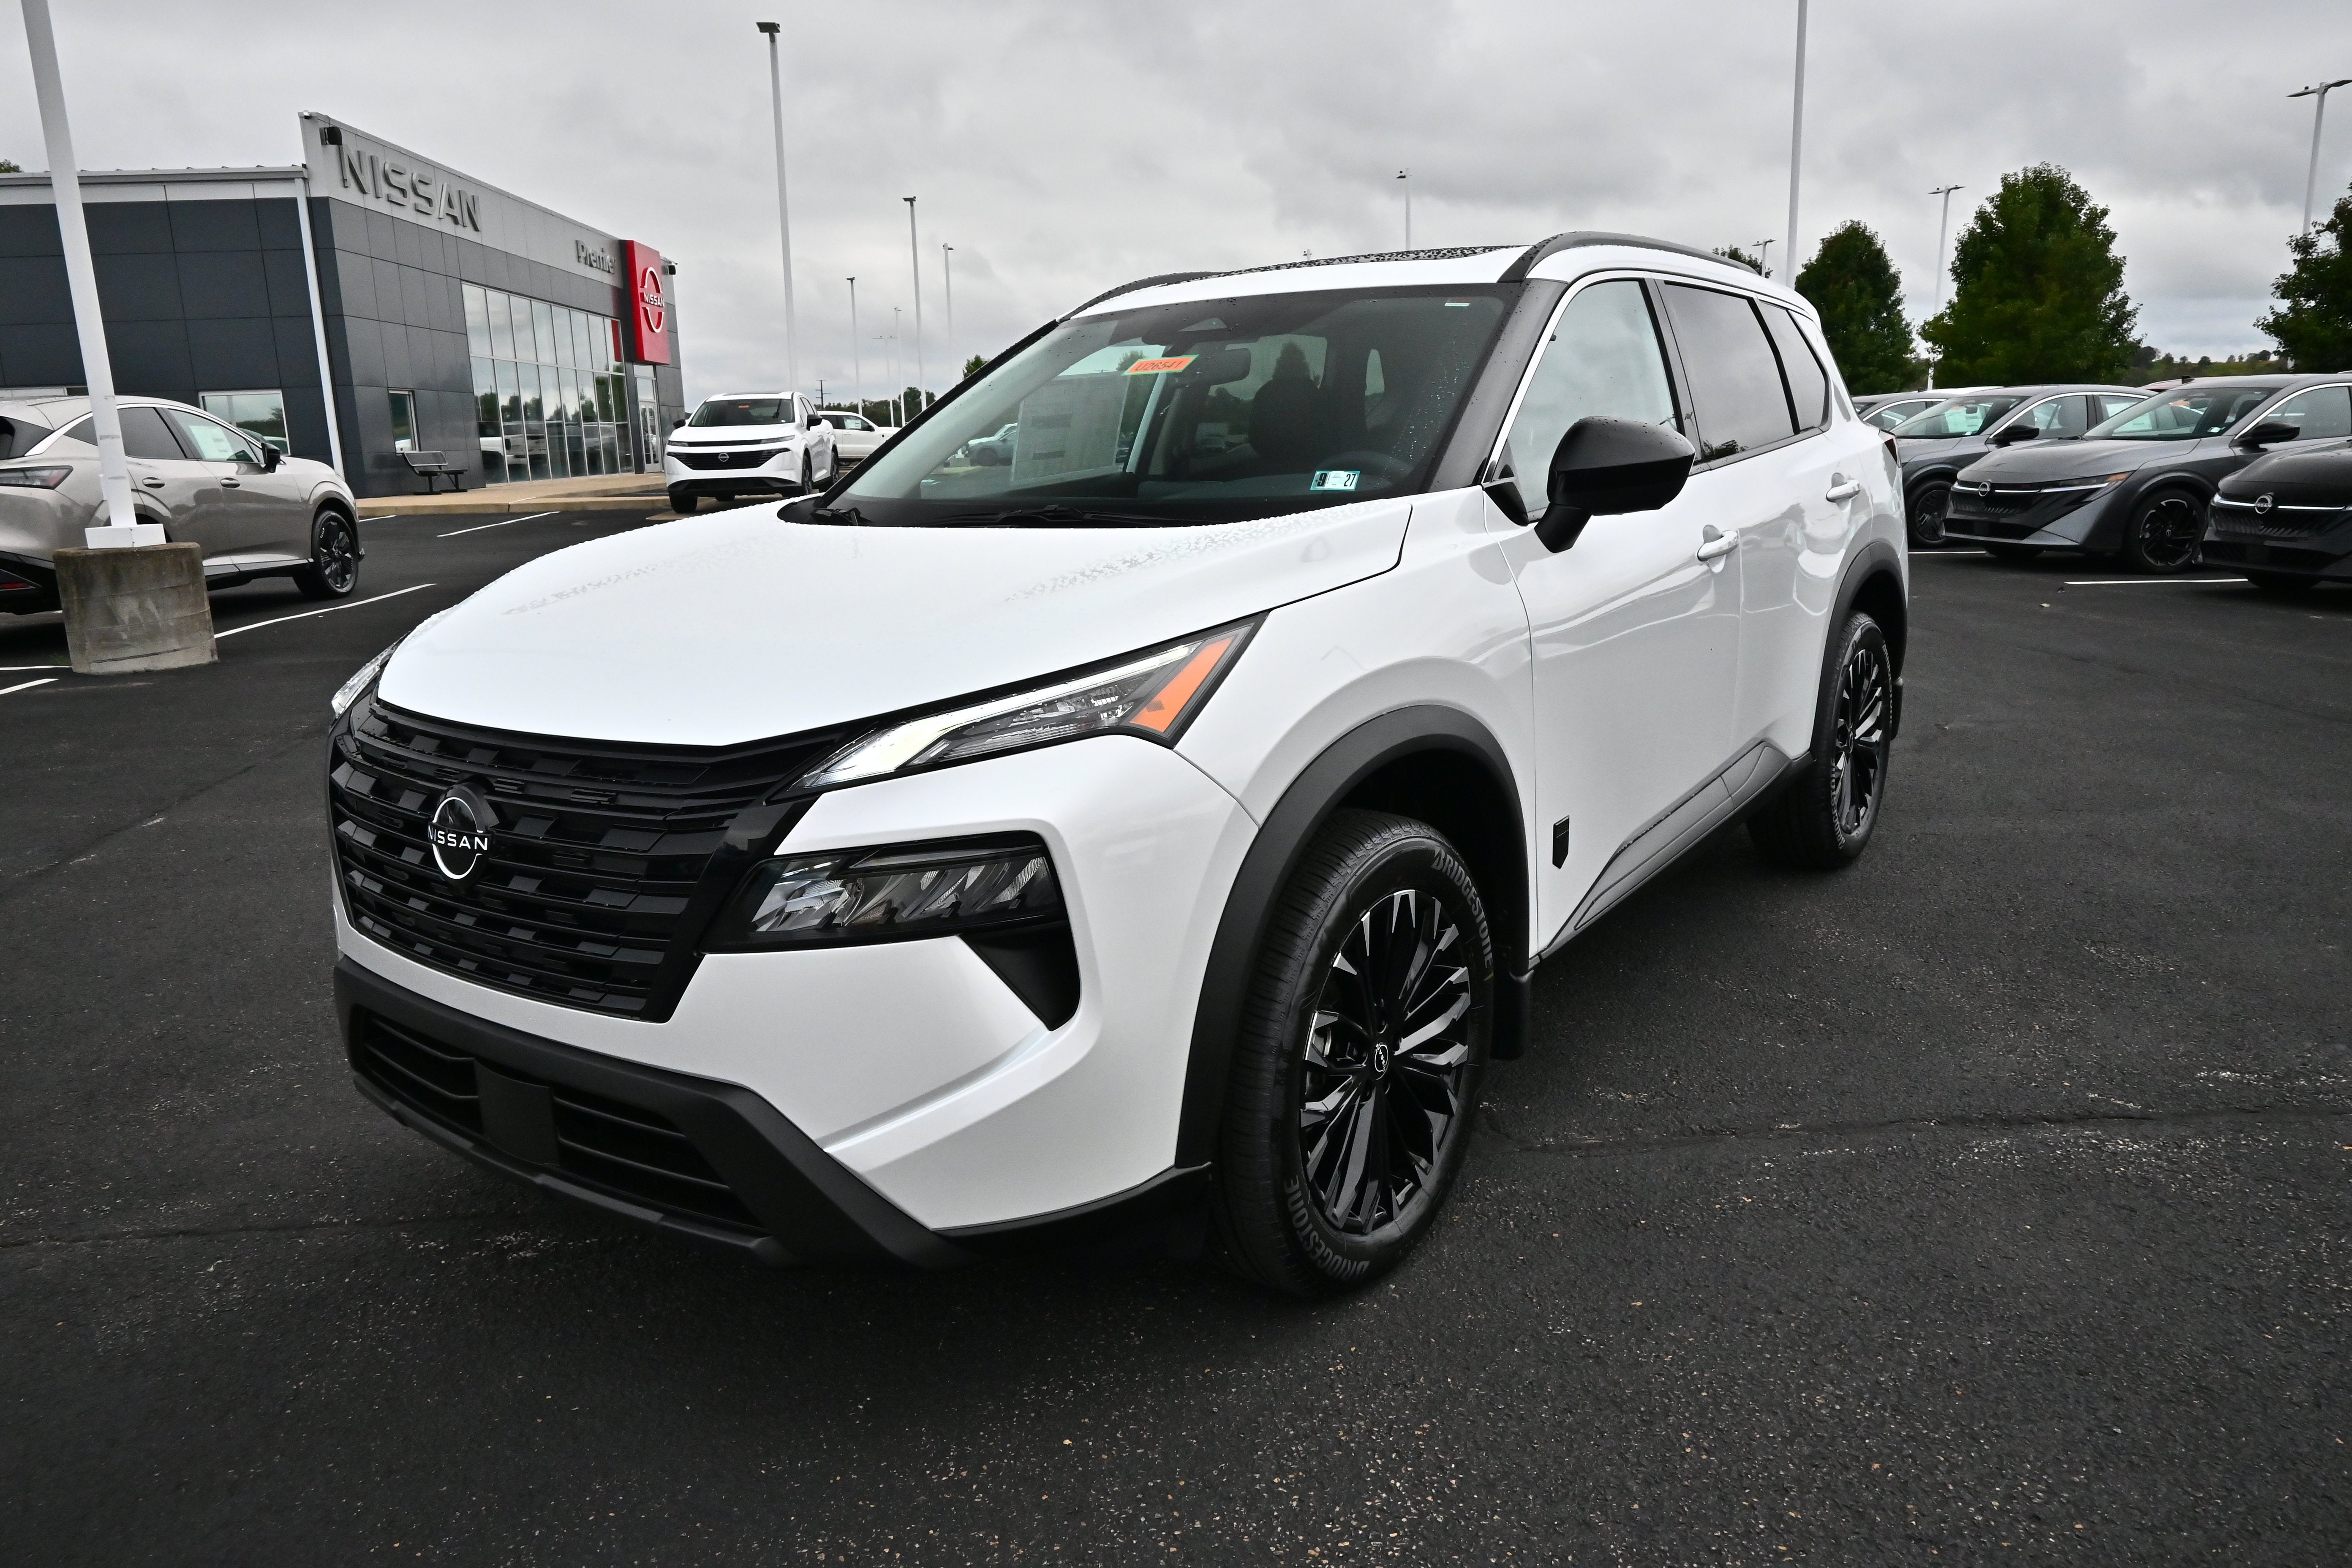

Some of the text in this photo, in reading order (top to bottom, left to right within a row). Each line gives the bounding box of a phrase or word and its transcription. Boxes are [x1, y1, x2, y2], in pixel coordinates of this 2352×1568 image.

[338, 144, 481, 231] NISSAN
[643, 292, 665, 308] NISSAN
[1135, 360, 1184, 371] U26541
[1317, 473, 1356, 487] 9 27
[427, 825, 488, 850] NISSAN
[1431, 845, 1493, 969] BRIDGESTONE
[1284, 1175, 1370, 1282] BRIDGESTONE
